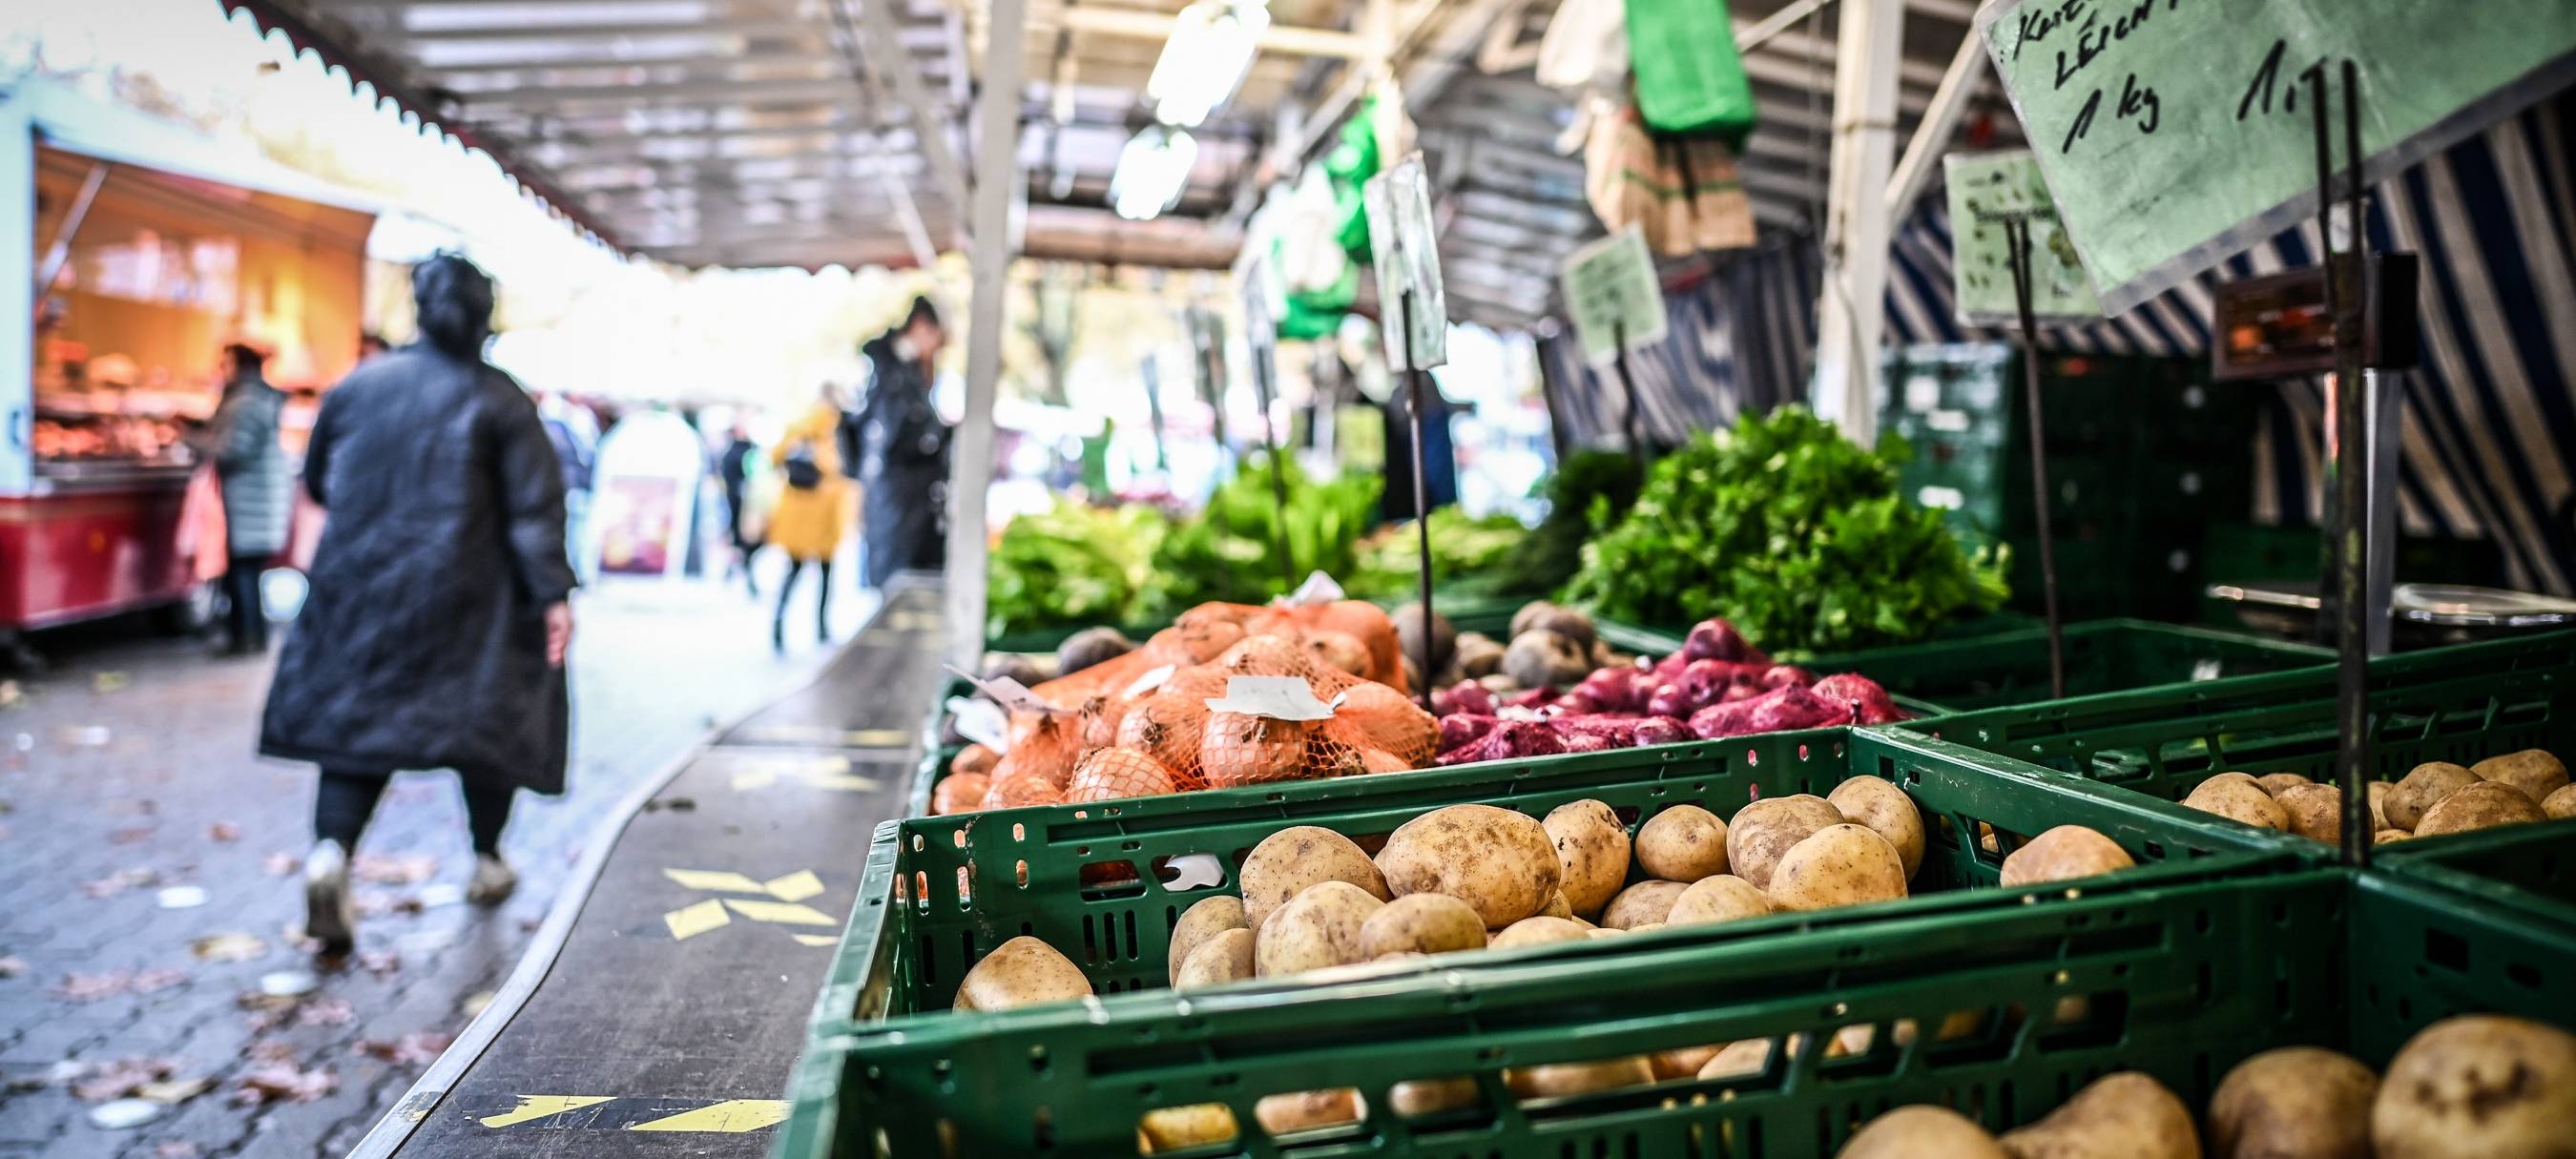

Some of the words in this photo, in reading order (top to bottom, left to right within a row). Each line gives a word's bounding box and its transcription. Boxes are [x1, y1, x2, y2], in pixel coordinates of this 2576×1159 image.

[2054, 0, 2177, 91] LEICH
[2062, 89, 2102, 155] 1
[2116, 72, 2160, 134] kg
